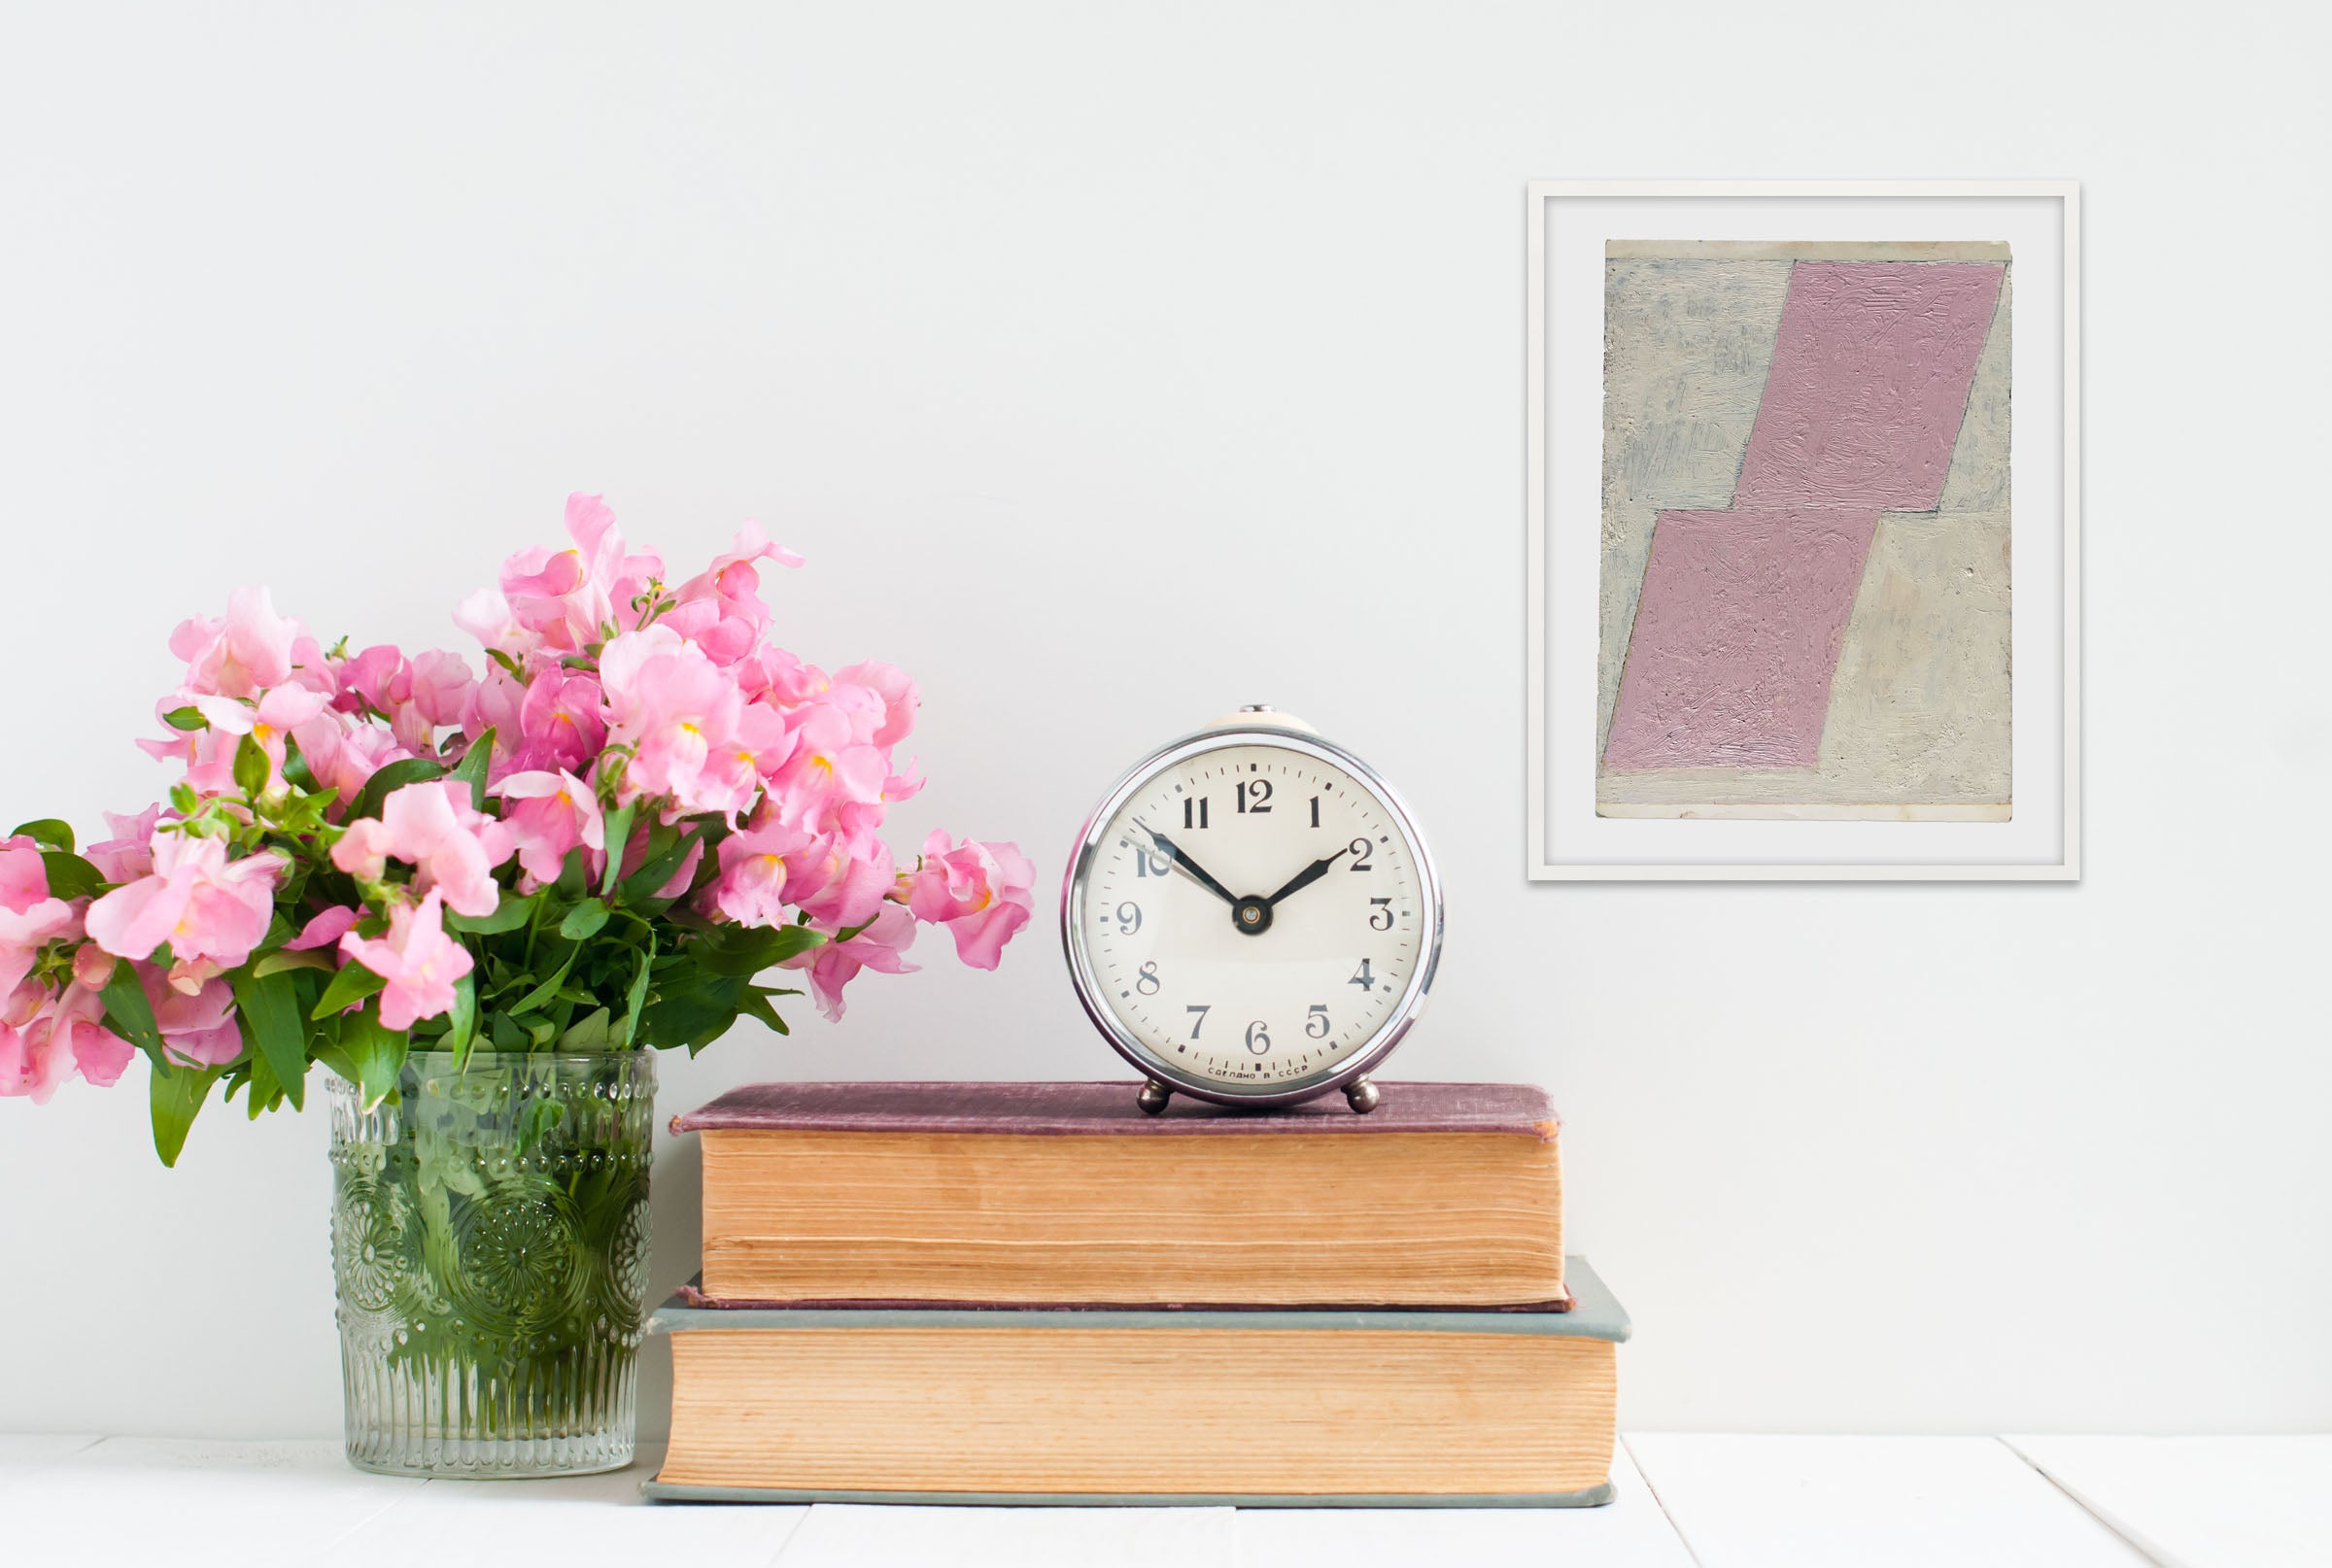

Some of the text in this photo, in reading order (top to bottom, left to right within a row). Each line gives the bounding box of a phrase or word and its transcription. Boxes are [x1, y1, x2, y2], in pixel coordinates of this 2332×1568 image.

[1183, 796, 1209, 829] 11
[1236, 779, 1273, 814] 12
[1309, 796, 1320, 828] 1
[1136, 843, 1173, 877] 10
[1349, 837, 1374, 871] 2
[1115, 901, 1143, 936] 9
[1369, 898, 1394, 931] 3
[1136, 961, 1160, 996] 8
[1348, 958, 1375, 992] 4
[1185, 1005, 1212, 1040] 7
[1245, 1020, 1271, 1055] 6
[1305, 1005, 1331, 1039] 5
